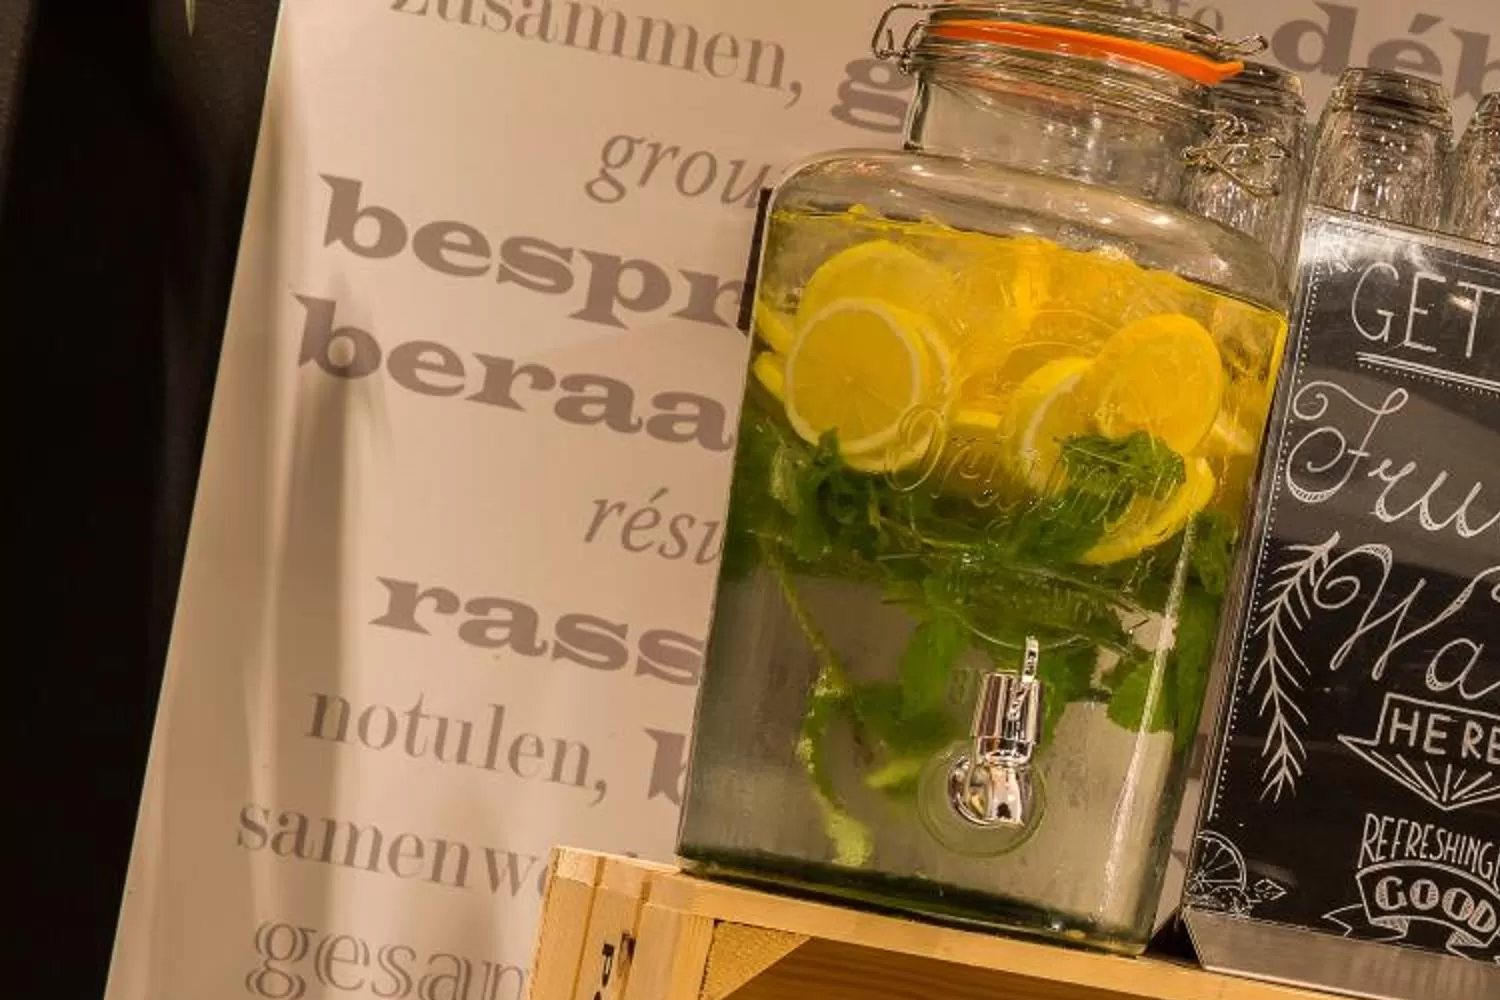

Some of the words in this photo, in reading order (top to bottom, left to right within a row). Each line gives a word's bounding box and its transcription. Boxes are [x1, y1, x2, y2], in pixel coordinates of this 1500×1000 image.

[304, 690, 608, 807] notulen,
[236, 802, 549, 898] samenw
[1375, 875, 1497, 933] GOOD
